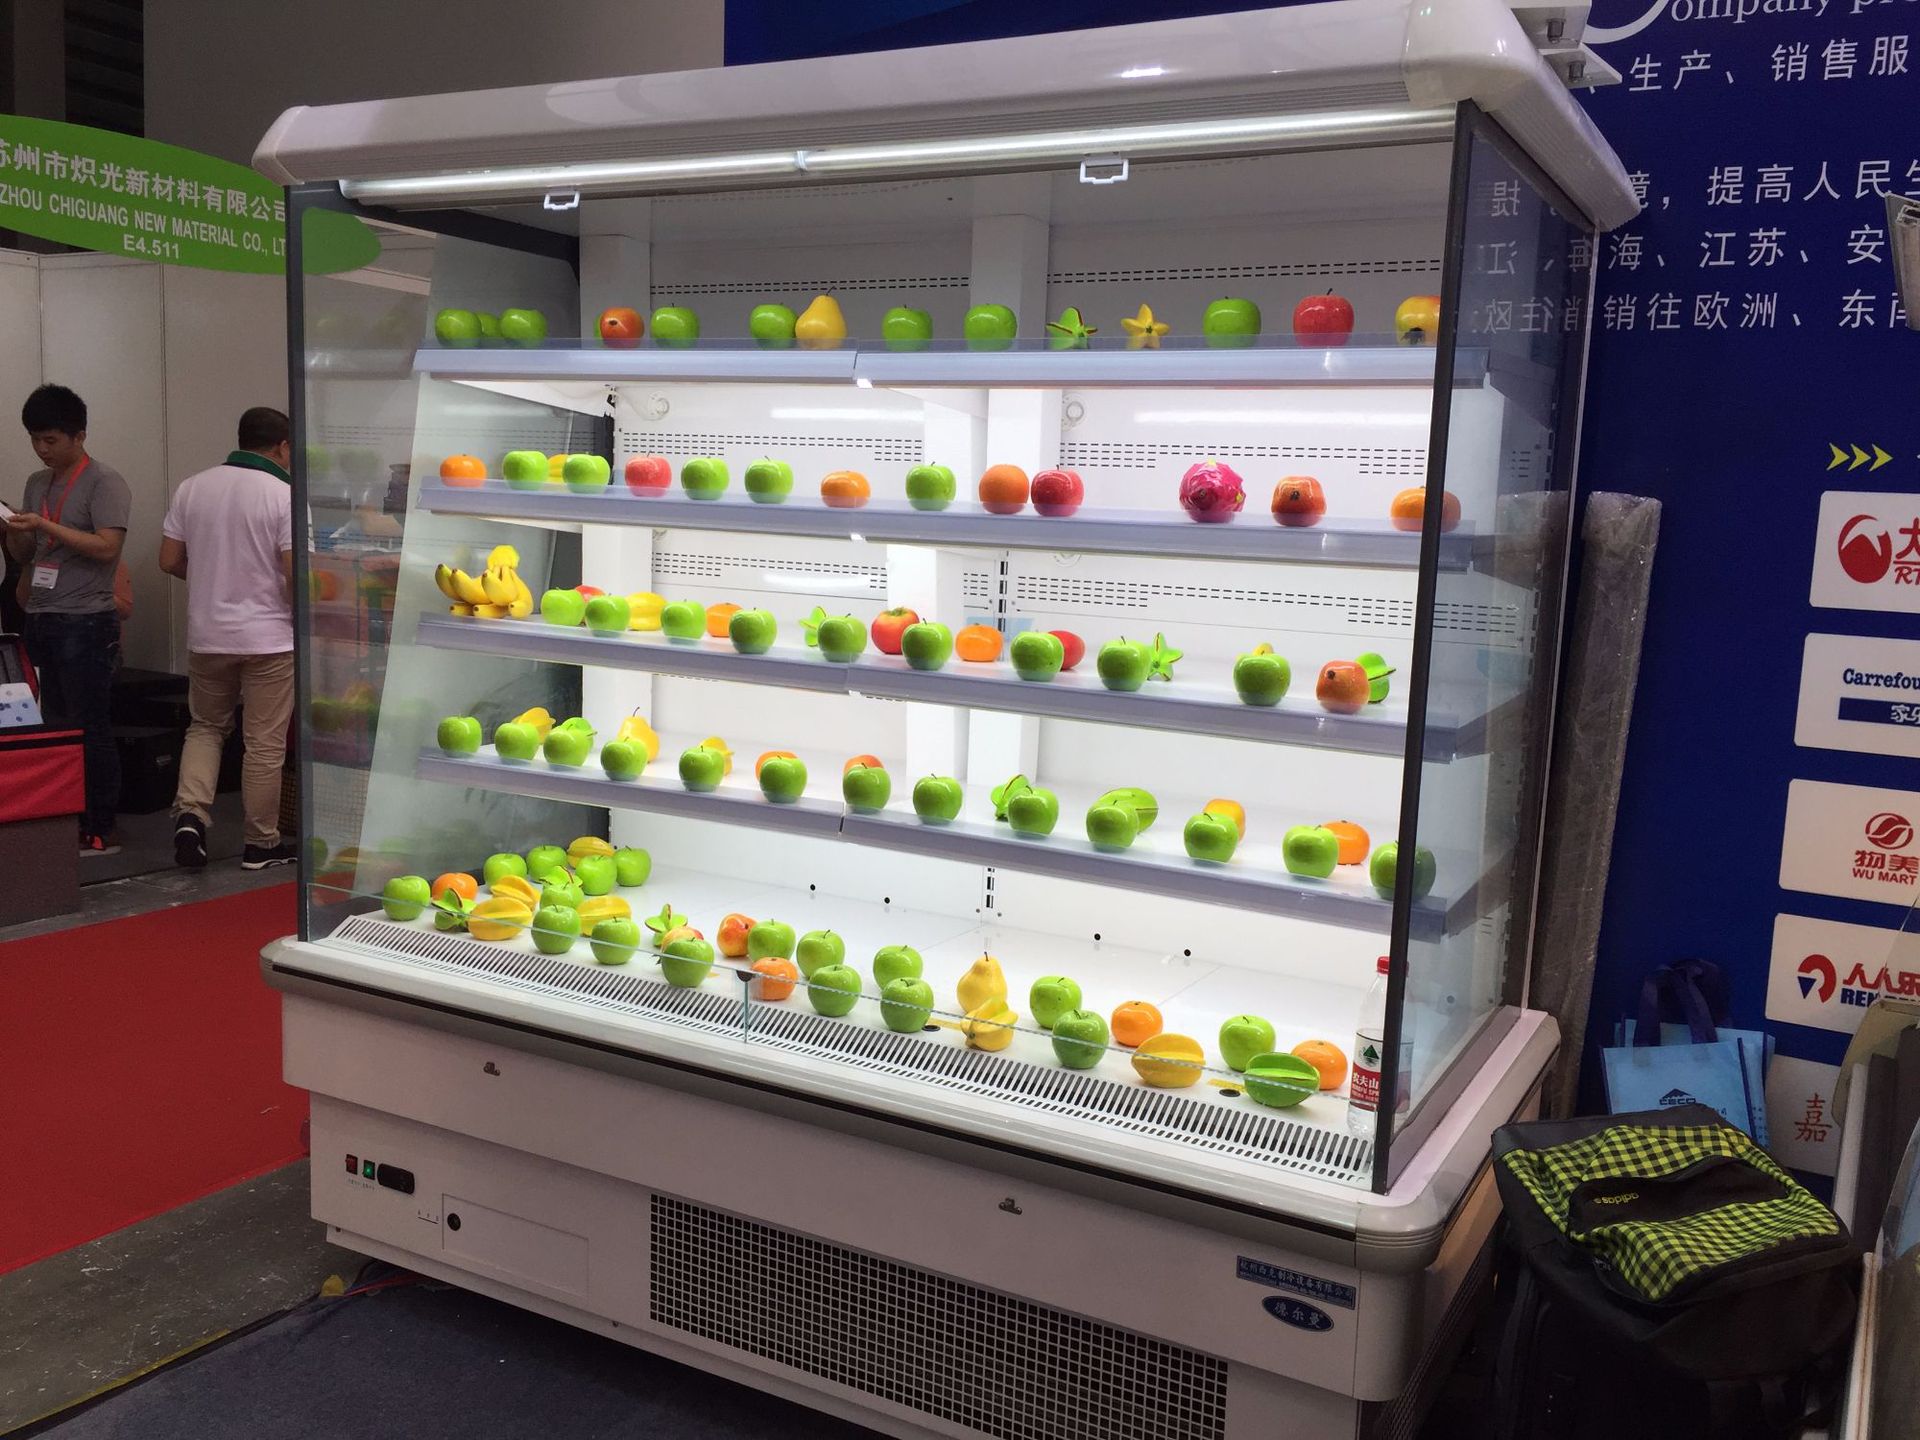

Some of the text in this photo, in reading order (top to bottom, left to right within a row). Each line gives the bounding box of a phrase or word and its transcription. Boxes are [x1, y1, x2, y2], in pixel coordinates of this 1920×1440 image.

[49, 193, 129, 227] CHIGUANG
[134, 210, 166, 233] NEW
[172, 216, 238, 248] MATERIAL
[242, 231, 268, 255] CO.,
[123, 233, 181, 260] E4.511
[1843, 667, 1920, 691] Carrefou
[1854, 850, 1919, 874] 物美
[1852, 867, 1917, 886] WU MART
[1794, 1092, 1832, 1143] 嘉
